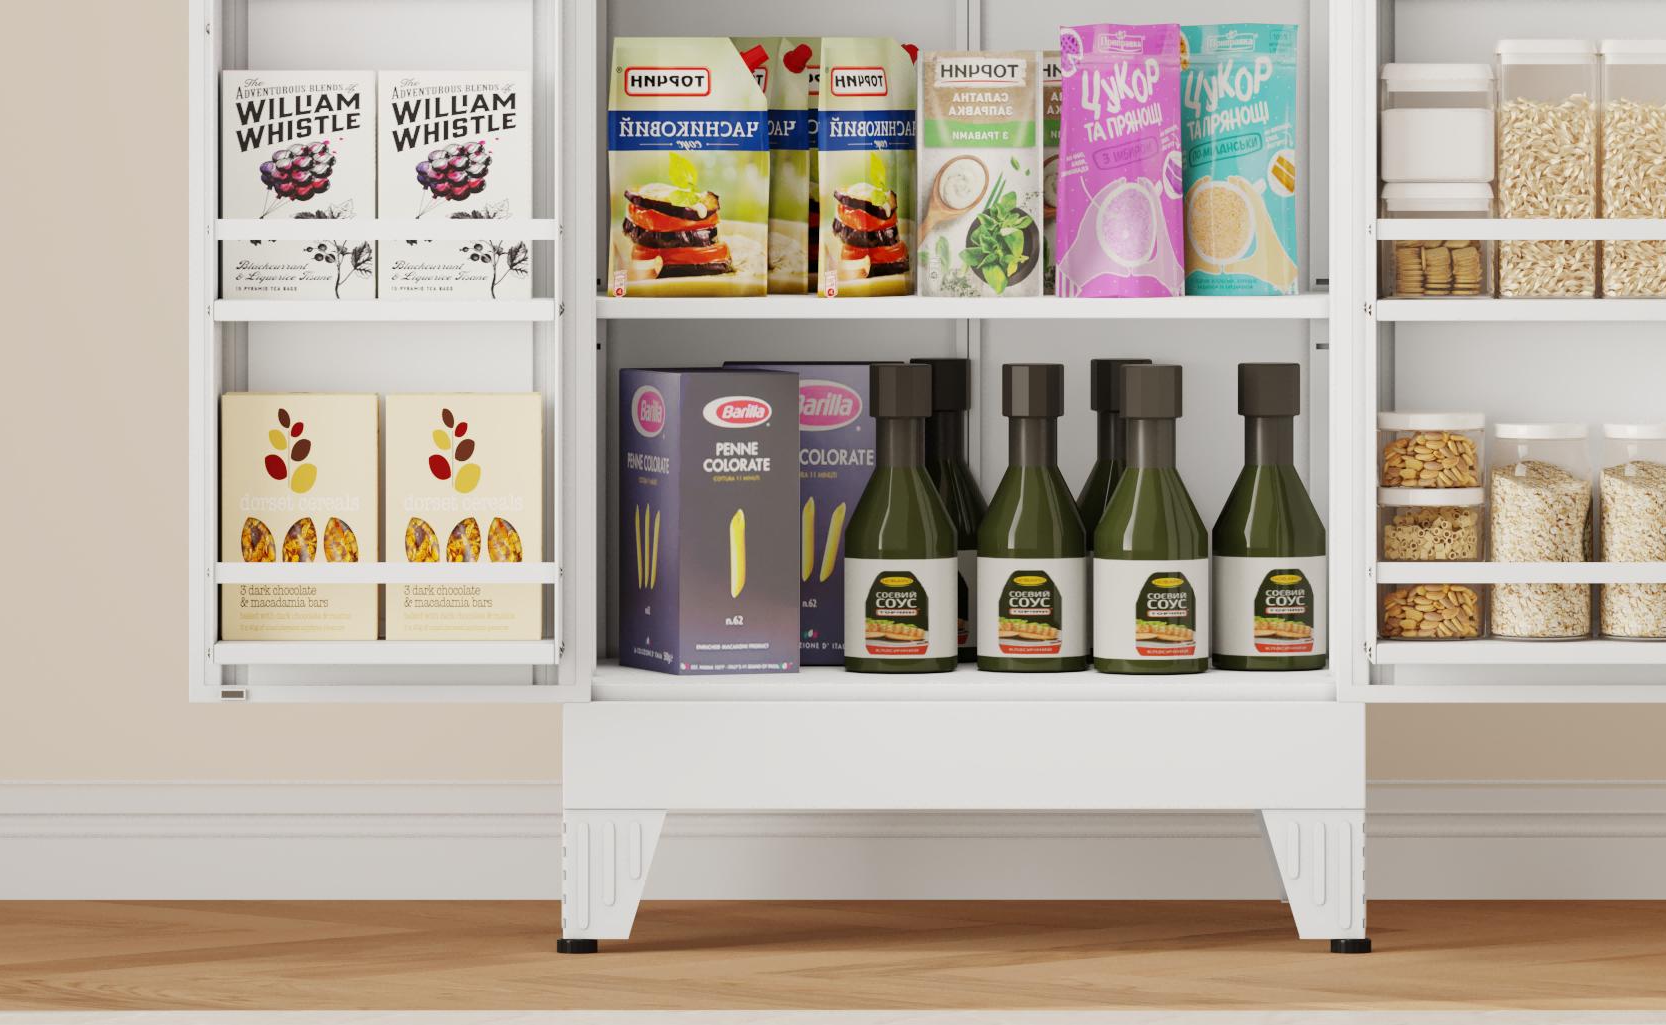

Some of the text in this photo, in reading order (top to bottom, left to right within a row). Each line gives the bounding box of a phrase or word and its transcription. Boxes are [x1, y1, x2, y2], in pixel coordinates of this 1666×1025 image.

[1081, 58, 1159, 120] ЦУКОР
[1185, 57, 1273, 118] ЦУКОР
[236, 93, 359, 126] WILLIAM
[392, 93, 515, 126] WILLIAM
[1084, 120, 1107, 143] ТА
[1106, 102, 1163, 139] ПРЯНОЩІ
[1187, 119, 1201, 141] ТА
[1202, 101, 1270, 138] ПРЯНОЩІ
[236, 113, 360, 152] WHISTLE
[392, 113, 516, 152] WHISTLE
[641, 400, 663, 423] Barilla
[722, 404, 765, 419] Barilla
[716, 441, 758, 456] PENNE
[627, 452, 670, 474] PENNE COLORATE
[800, 449, 874, 466] COLORATE
[703, 458, 770, 473] COLORATE
[240, 494, 360, 512] dorset cereals
[404, 494, 524, 512] dorset cereals
[240, 584, 317, 595] 3 dark chocolate
[404, 584, 481, 595] 3 dark chocolate
[876, 591, 917, 599] СОЄВИЙ
[1009, 590, 1051, 598] СОЄВИЙ
[1147, 592, 1187, 600] СОЄВИЙ
[240, 596, 329, 607] & macadamia bars
[404, 596, 493, 607] & macadamia bars
[802, 599, 817, 608] n.62
[876, 598, 917, 608] СОУС
[1009, 598, 1051, 607] СОУС
[1147, 599, 1187, 610] СОУС
[1265, 596, 1305, 606] СОУС
[725, 615, 744, 626] n.62
